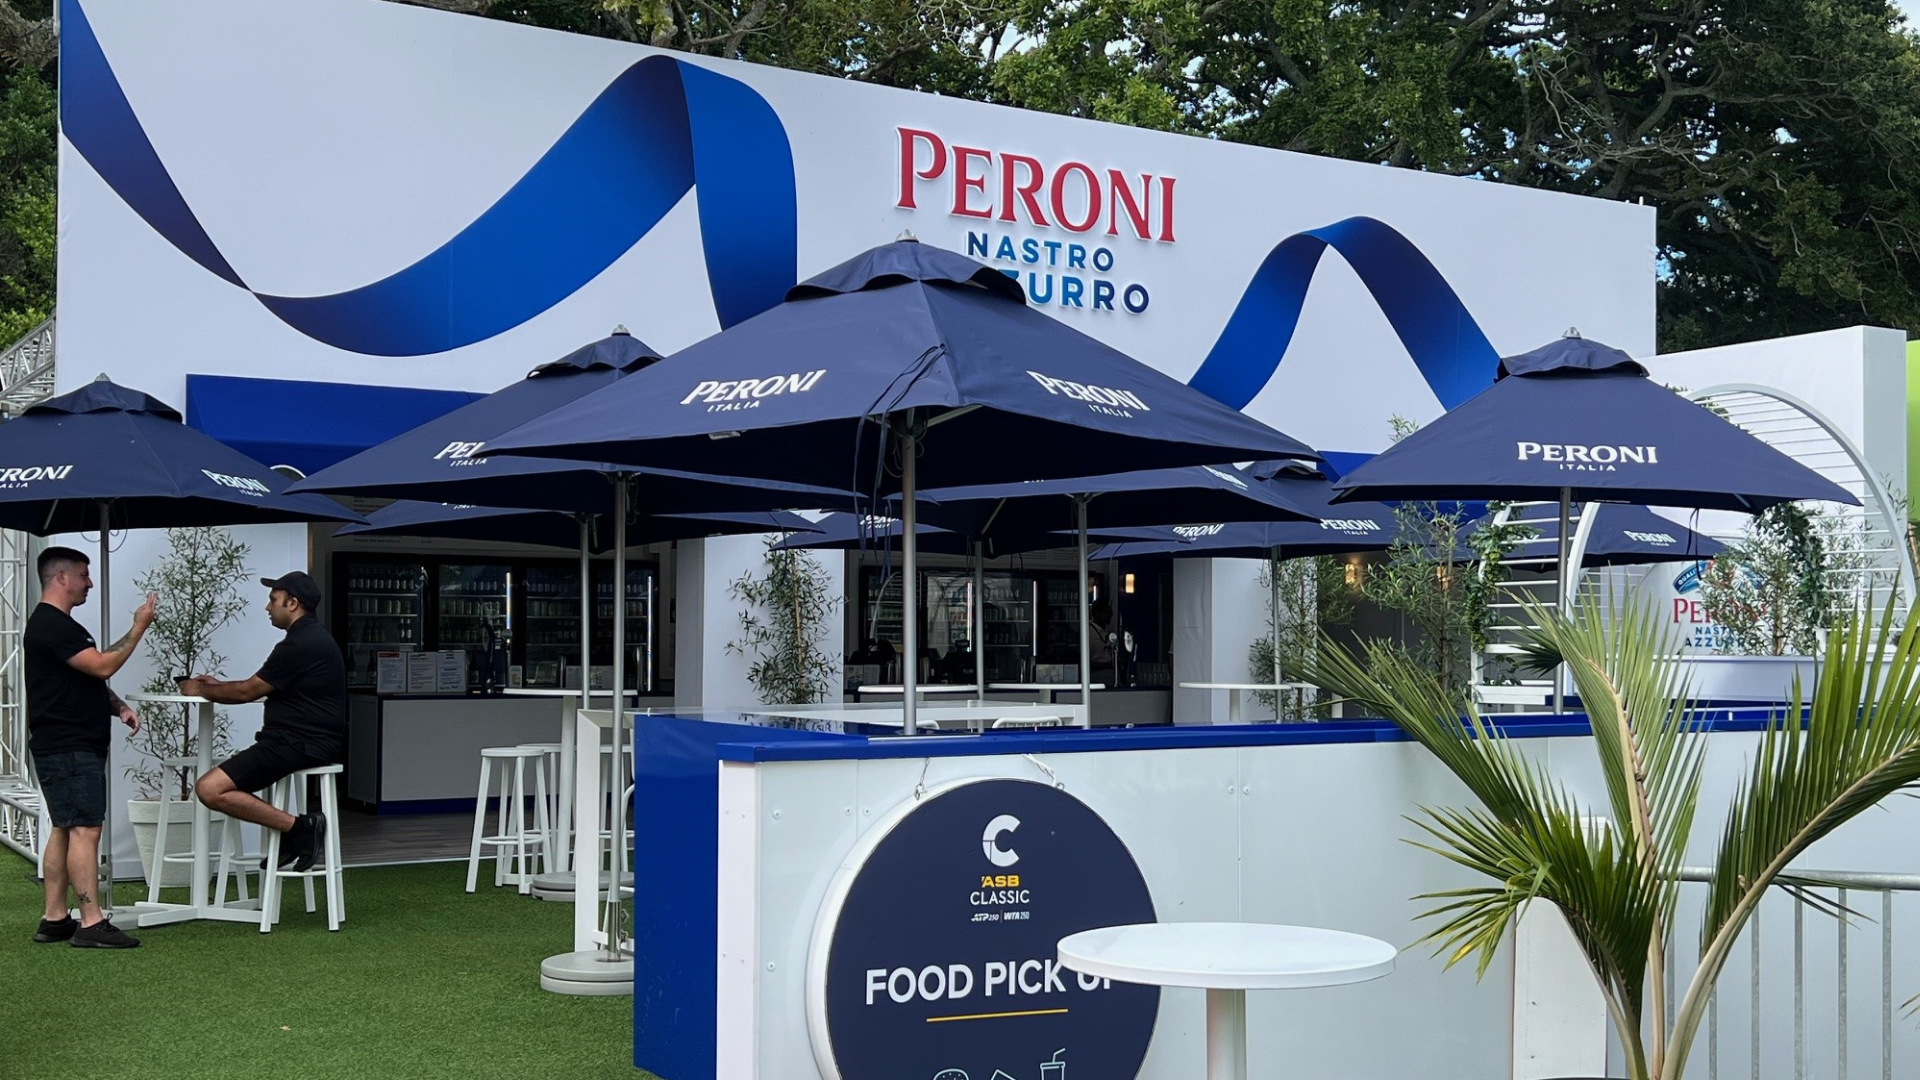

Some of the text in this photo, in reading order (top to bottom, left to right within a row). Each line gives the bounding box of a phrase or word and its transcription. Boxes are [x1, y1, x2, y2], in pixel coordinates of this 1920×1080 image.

[897, 127, 1177, 243] PERONI
[967, 231, 1114, 272] NASTRO
[998, 269, 1150, 314] URRO
[680, 369, 827, 405] PERONI
[1026, 370, 1151, 411] PERONI
[707, 400, 761, 412] ITALIA
[1088, 404, 1133, 418] ITALIA
[449, 458, 488, 467] ITALIA
[1516, 441, 1659, 464] PERONI
[1559, 463, 1617, 472] ITALIA
[200, 468, 271, 493] PERONI
[1320, 518, 1382, 531] PERONI
[970, 889, 1030, 906] CLASSIC
[865, 964, 974, 1005] FOOD
[984, 959, 1067, 997] PICK
